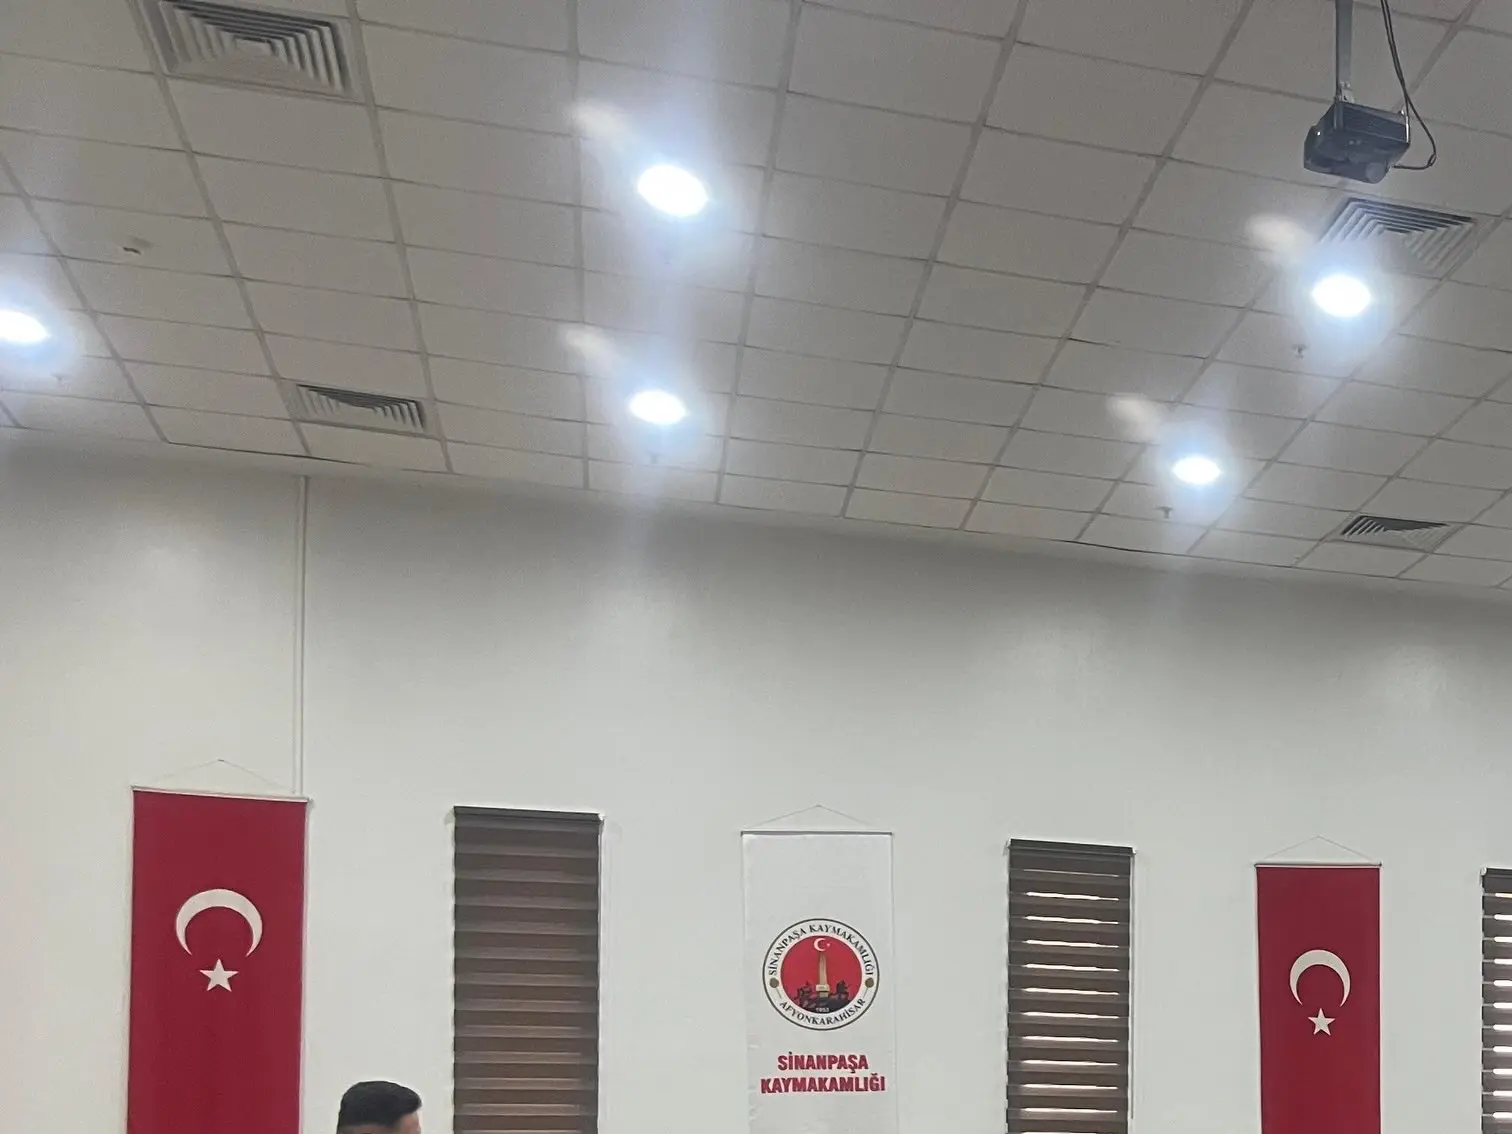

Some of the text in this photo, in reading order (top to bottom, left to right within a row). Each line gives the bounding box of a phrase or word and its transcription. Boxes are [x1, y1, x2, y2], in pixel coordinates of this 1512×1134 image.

[767, 924, 875, 976] SİNANPAŞA KAYMAKAMLIĞI
[780, 998, 866, 1025] AFYONKARAHİSAR
[777, 1051, 869, 1074] SİNANPAŞA
[760, 1073, 886, 1094] KAYMAKAMLIĞI
